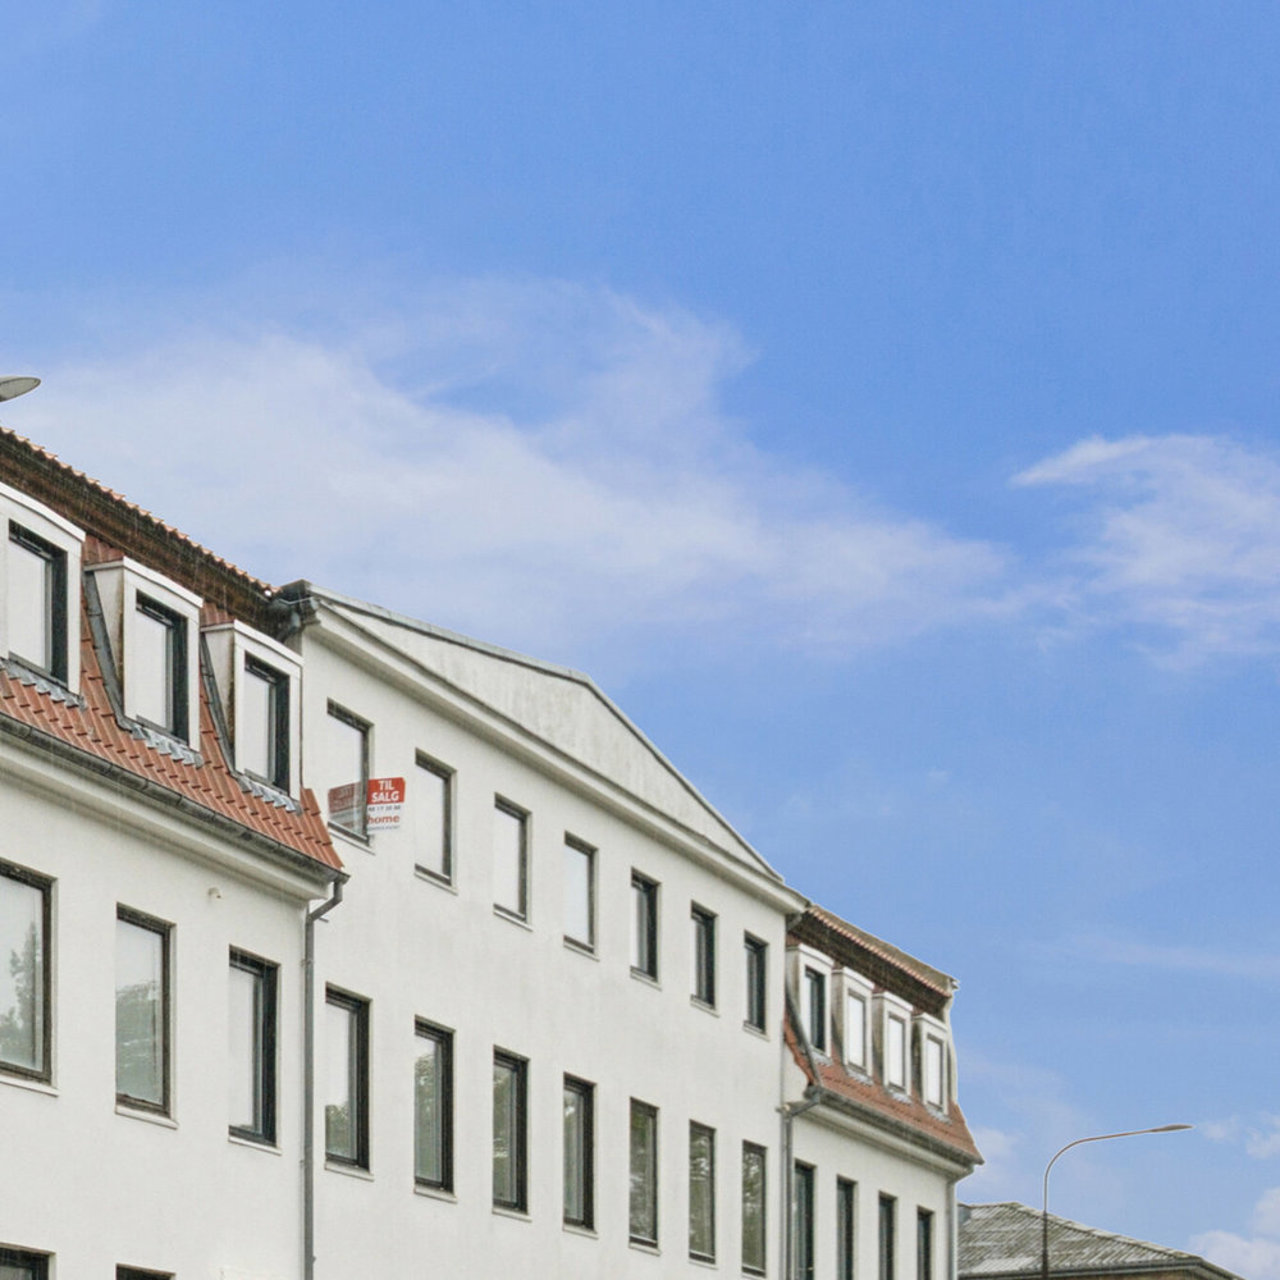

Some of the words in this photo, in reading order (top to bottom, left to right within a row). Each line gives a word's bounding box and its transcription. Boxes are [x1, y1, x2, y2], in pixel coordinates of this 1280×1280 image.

[378, 780, 395, 790] TIL
[371, 791, 399, 802] SALG
[368, 814, 399, 824] home
